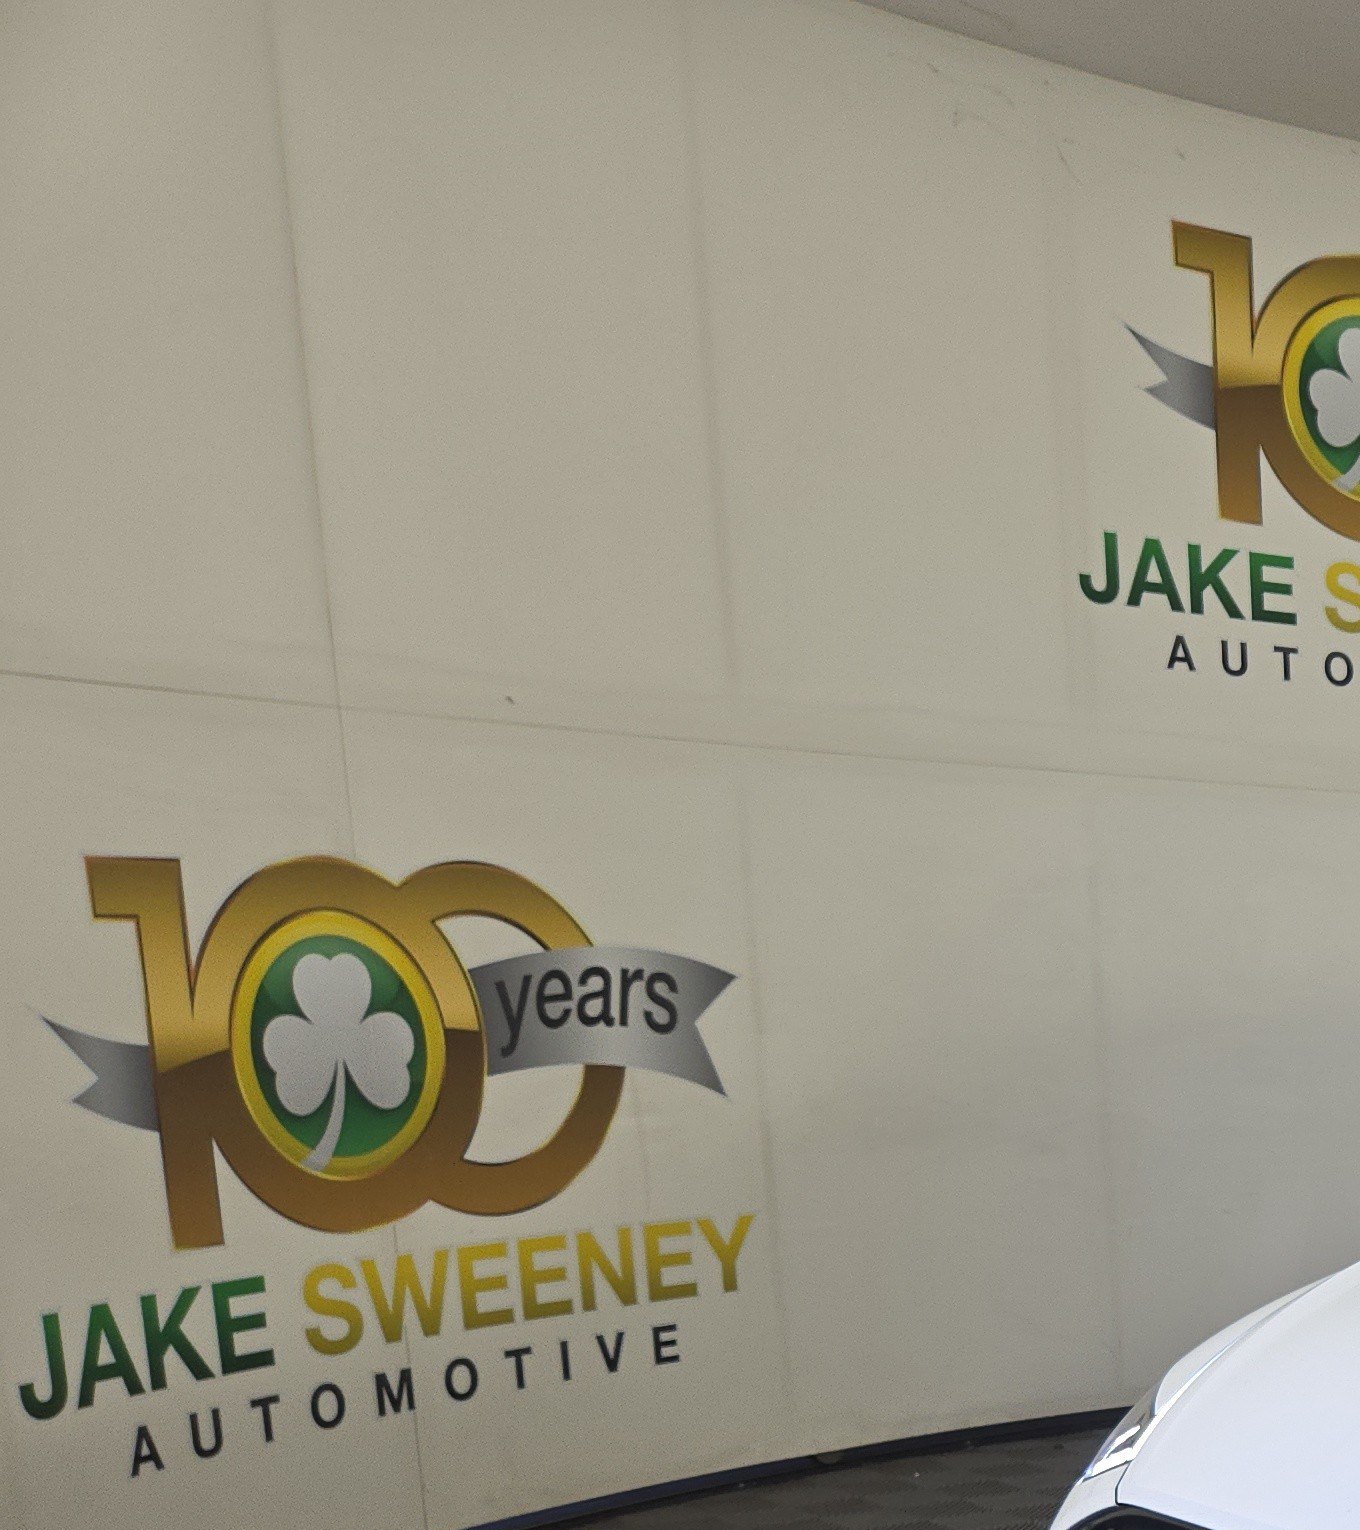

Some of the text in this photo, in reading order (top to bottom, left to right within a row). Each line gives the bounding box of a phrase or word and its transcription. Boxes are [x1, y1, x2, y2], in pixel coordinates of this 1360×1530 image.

[1078, 531, 1298, 625] JAKE
[496, 963, 679, 1056] years
[18, 1214, 756, 1420] JAKE SWEENEY
[130, 1324, 681, 1478] AUTOMOTIVE
